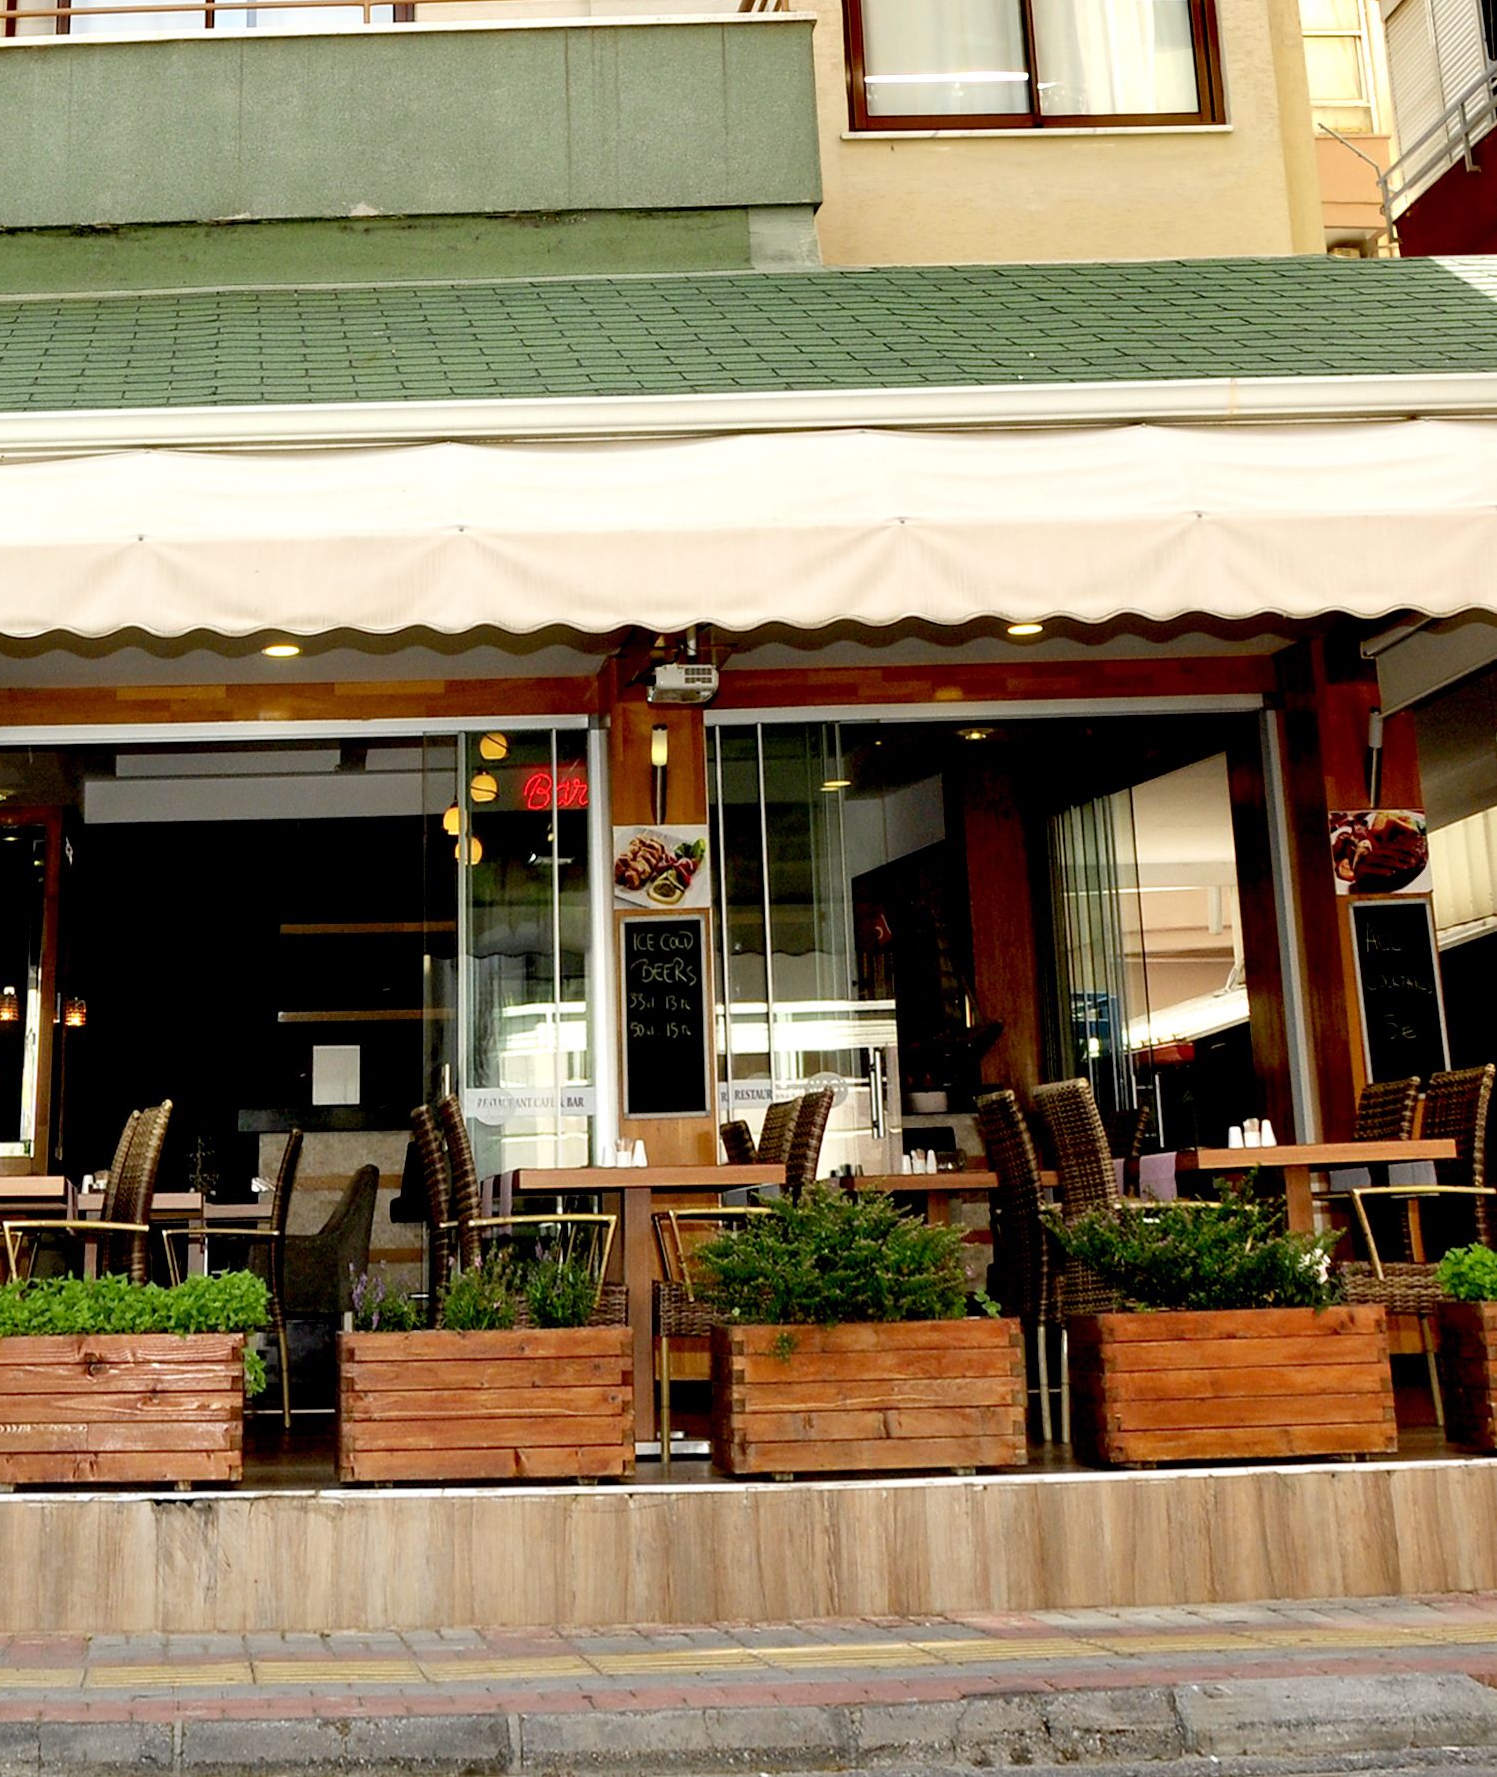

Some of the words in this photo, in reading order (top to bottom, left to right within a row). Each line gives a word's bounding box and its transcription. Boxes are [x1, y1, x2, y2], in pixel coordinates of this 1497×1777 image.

[523, 772, 589, 810] Bar
[633, 932, 655, 952] ICE
[566, 1096, 585, 1108] BAR
